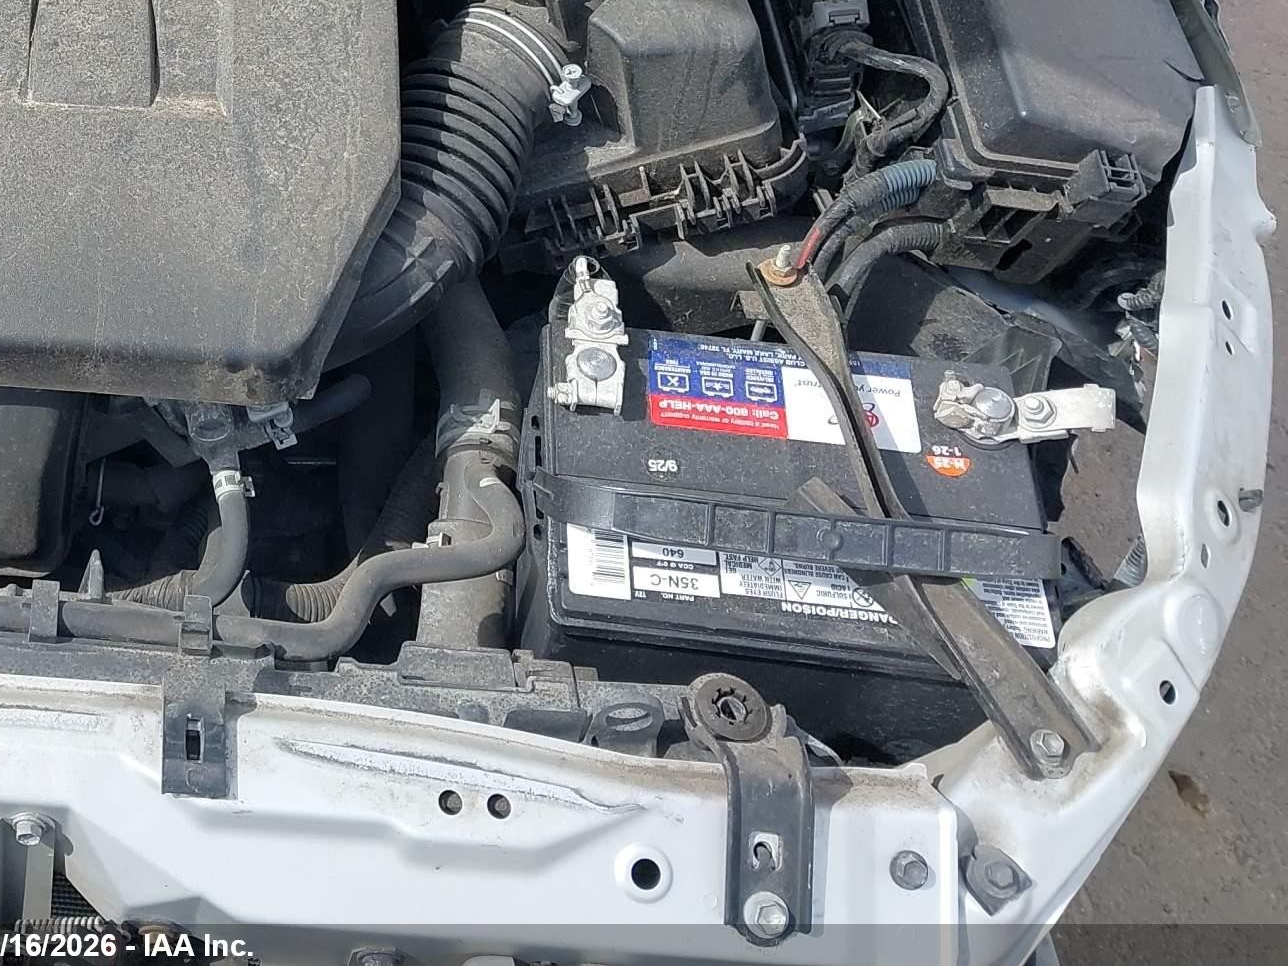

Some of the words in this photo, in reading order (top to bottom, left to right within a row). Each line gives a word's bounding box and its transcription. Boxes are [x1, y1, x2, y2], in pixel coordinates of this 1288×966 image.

[868, 387, 900, 397] Power
[658, 400, 748, 417] 800-AAA-HELP
[752, 409, 779, 420] Call:
[932, 445, 961, 456] 1-26
[648, 459, 678, 472] 9/25
[662, 548, 684, 558] 640
[723, 554, 741, 562] FAST.
[743, 555, 759, 563] HELP
[724, 560, 752, 569] MEDICAL
[650, 573, 699, 590] 35N-C
[741, 574, 763, 582] WATER
[739, 581, 782, 591] IMMEDIATELY
[763, 590, 783, 598] FLUSH
